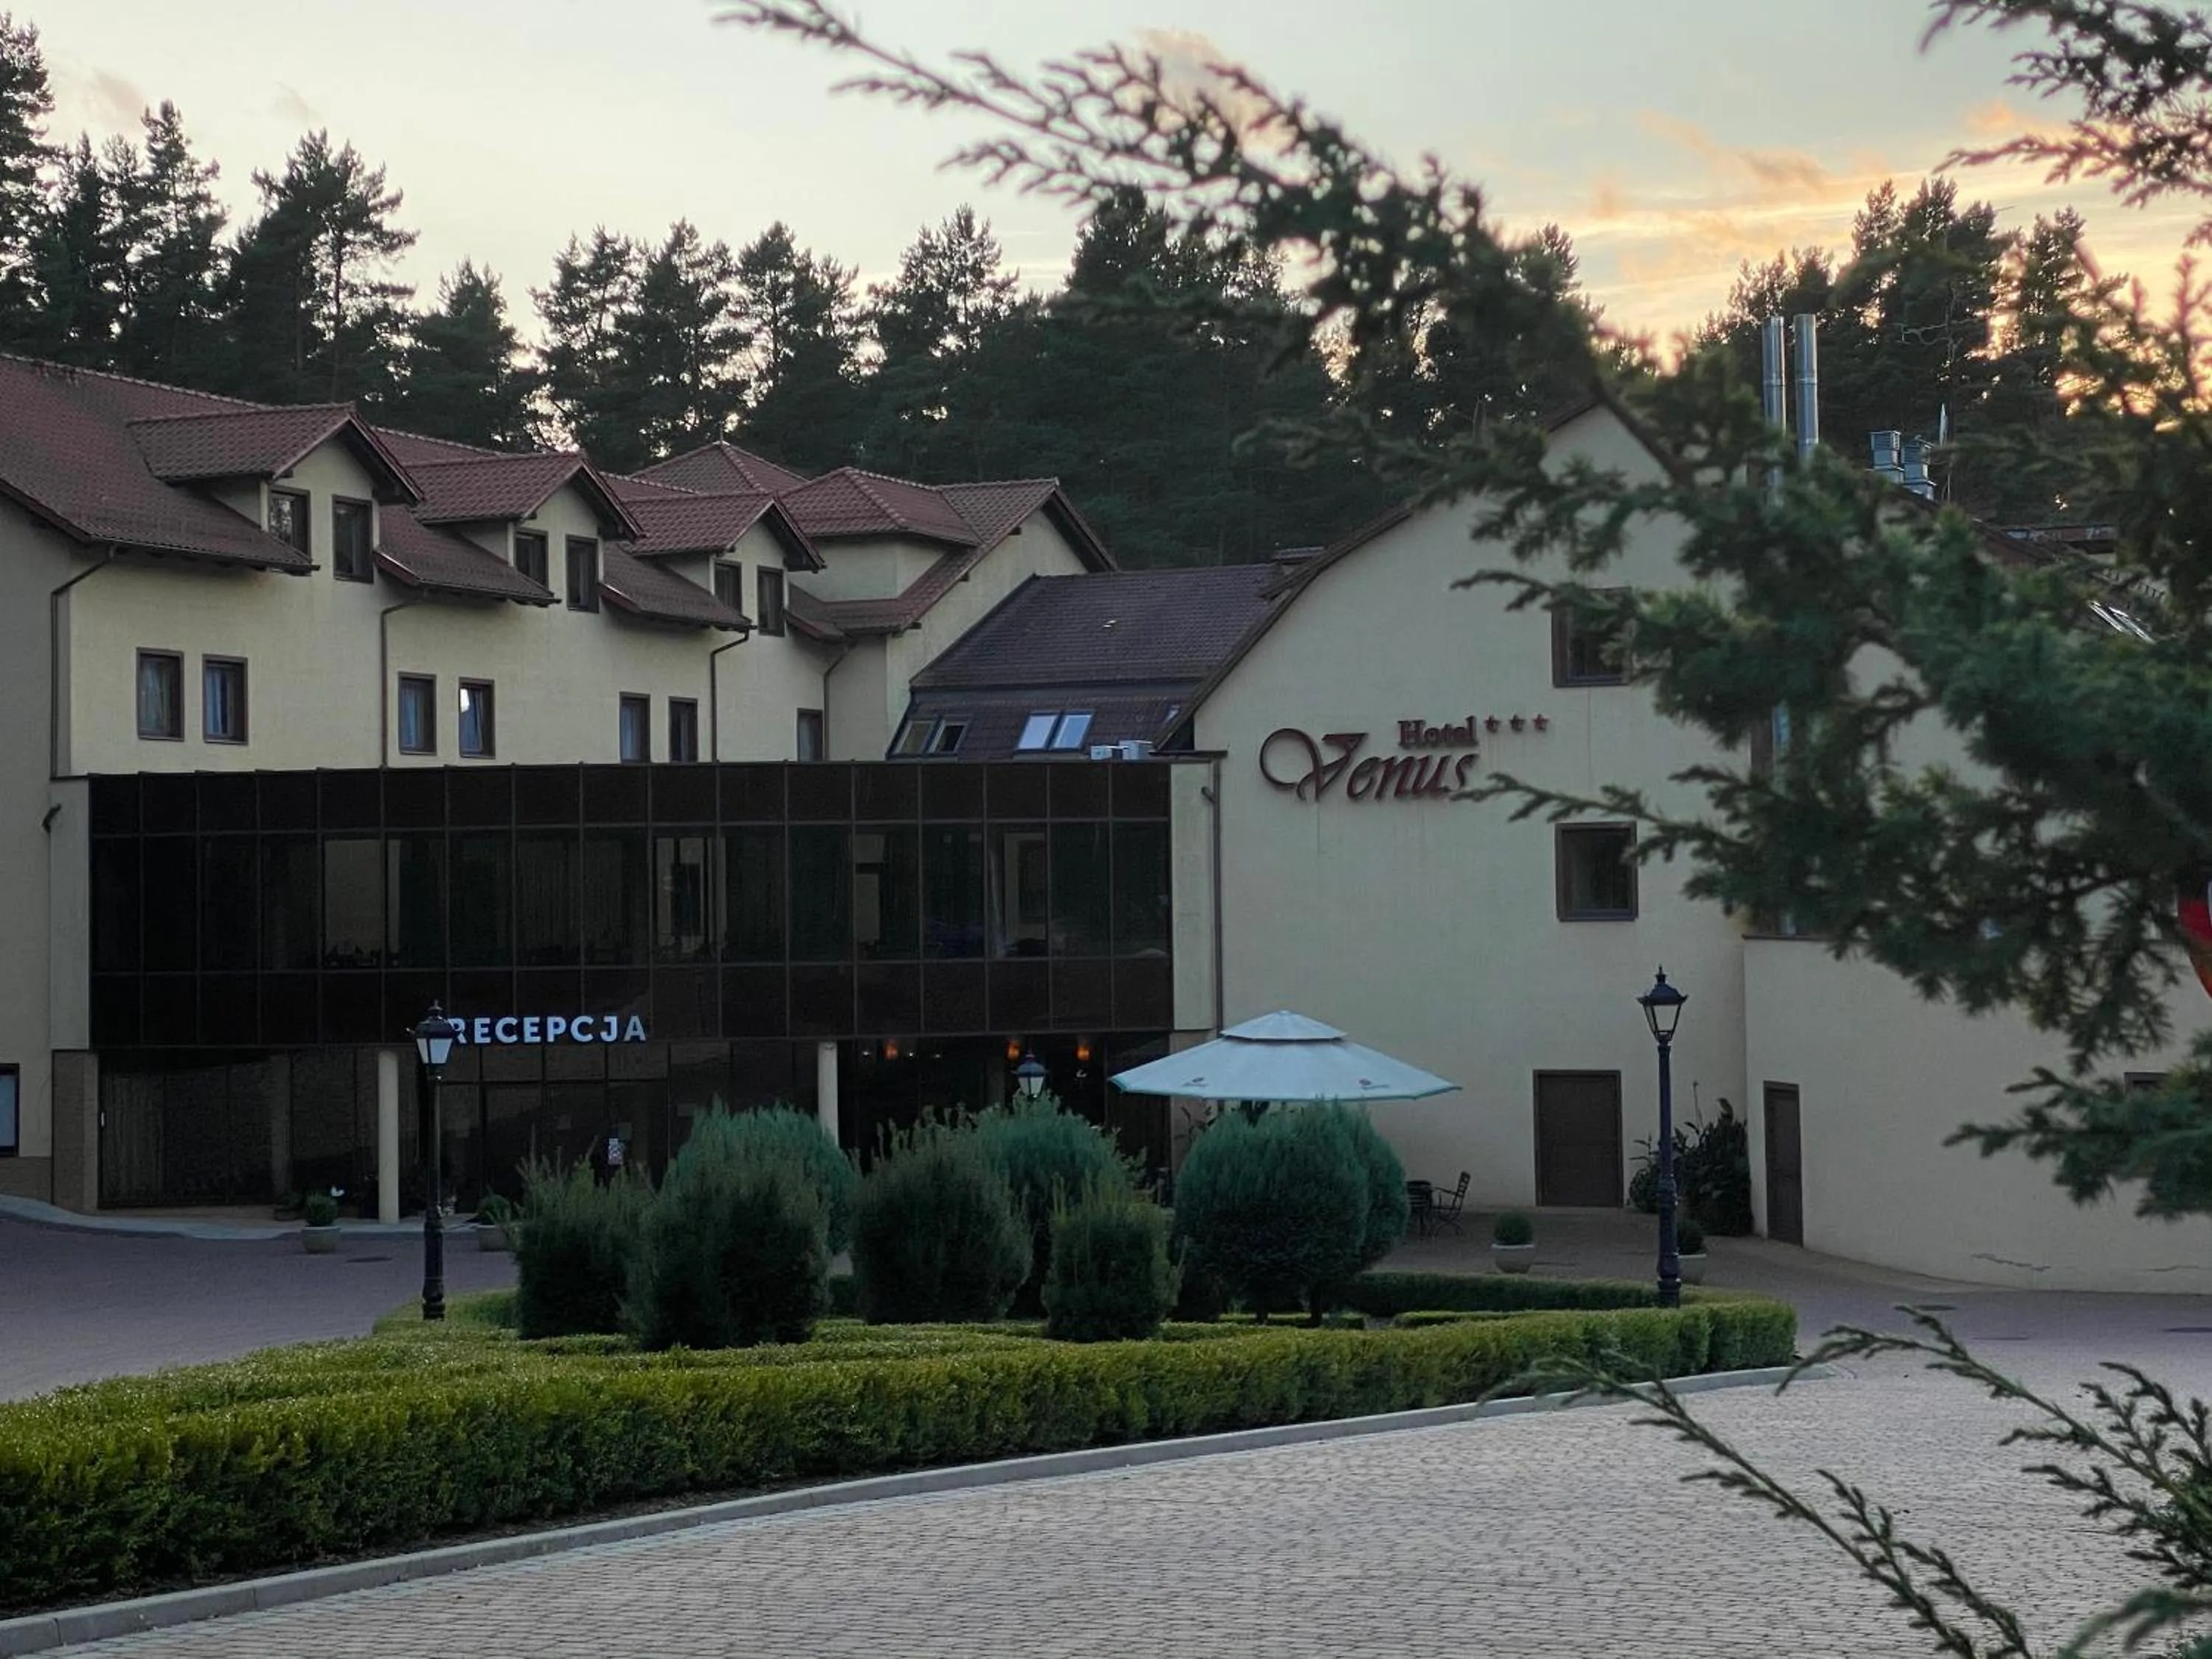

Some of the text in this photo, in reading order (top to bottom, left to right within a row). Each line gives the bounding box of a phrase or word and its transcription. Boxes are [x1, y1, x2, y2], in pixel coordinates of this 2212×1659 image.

[1398, 715, 1478, 747] Hotel
[1259, 728, 1479, 801] Venus
[448, 1015, 647, 1044] RECEPCJA
